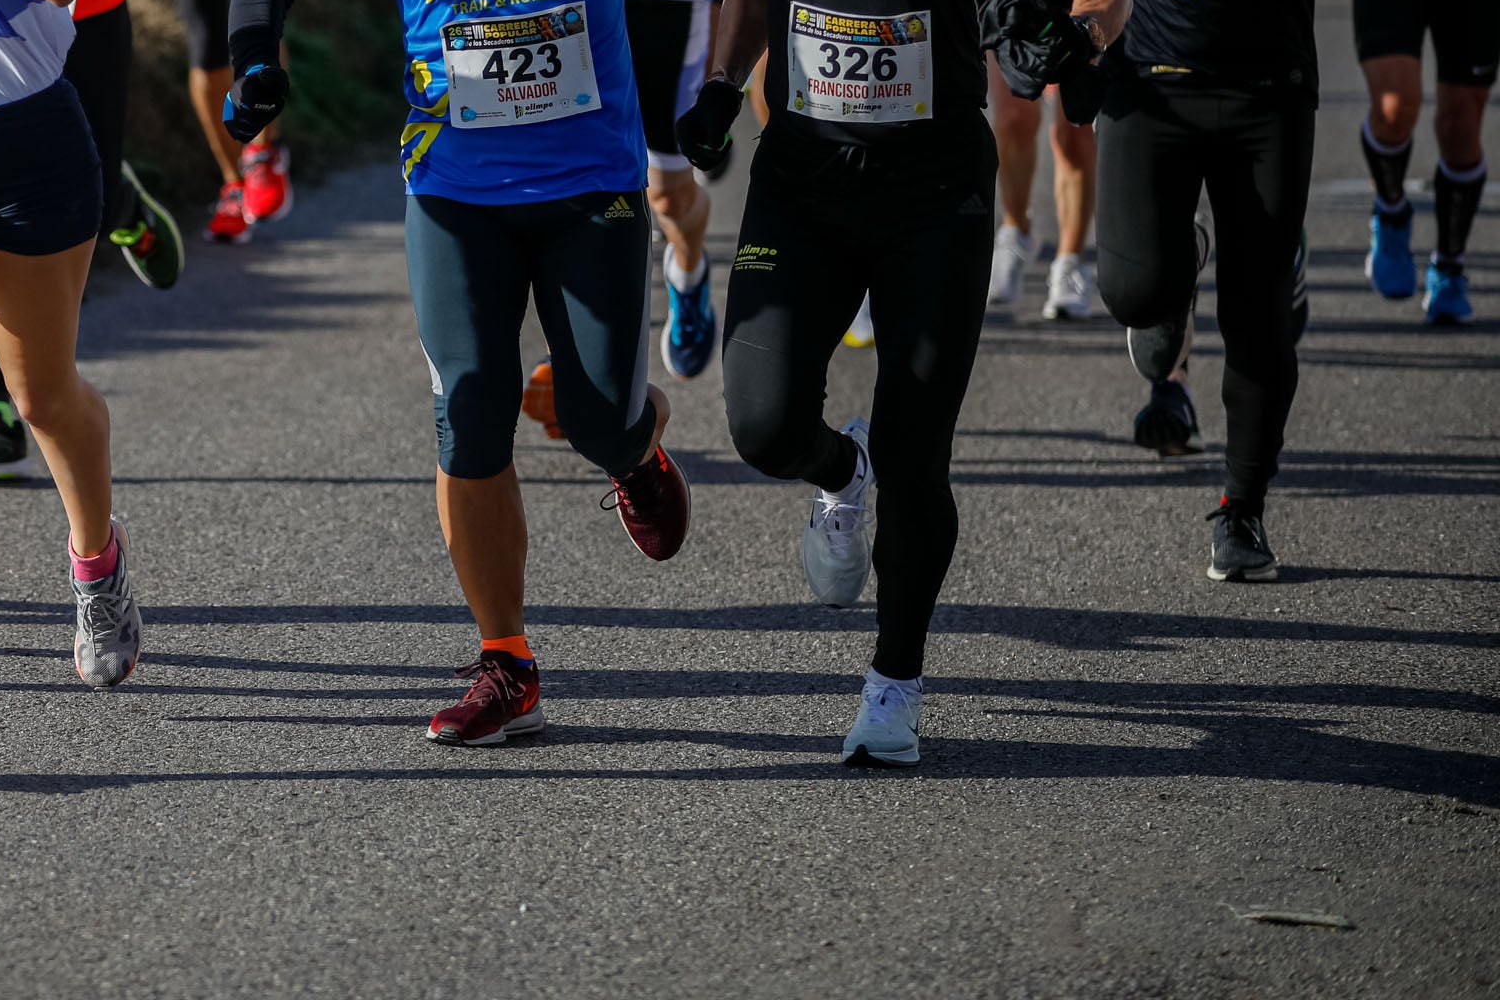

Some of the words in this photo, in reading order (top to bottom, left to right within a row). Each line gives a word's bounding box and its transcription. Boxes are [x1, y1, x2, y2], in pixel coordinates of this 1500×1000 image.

[825, 15, 877, 29] CARRERA
[448, 27, 462, 36] 26
[472, 25, 484, 39] VII
[484, 20, 537, 32] CARRERA
[485, 28, 537, 39] POPULAR
[795, 23, 807, 32] Ruta
[807, 26, 814, 34] de
[814, 28, 822, 36] los
[823, 31, 852, 41] Secaderos
[825, 24, 877, 36] POPULAR
[473, 39, 482, 47] los
[483, 37, 514, 47] Secaderos
[482, 43, 562, 84] 423
[818, 43, 897, 81] 326
[497, 81, 557, 103] SALVADOR
[808, 78, 869, 99] FRANCISCO
[872, 83, 911, 99] JAVIER
[525, 101, 553, 111] olimpo
[853, 103, 882, 112] olimpo
[604, 209, 635, 218] adidas
